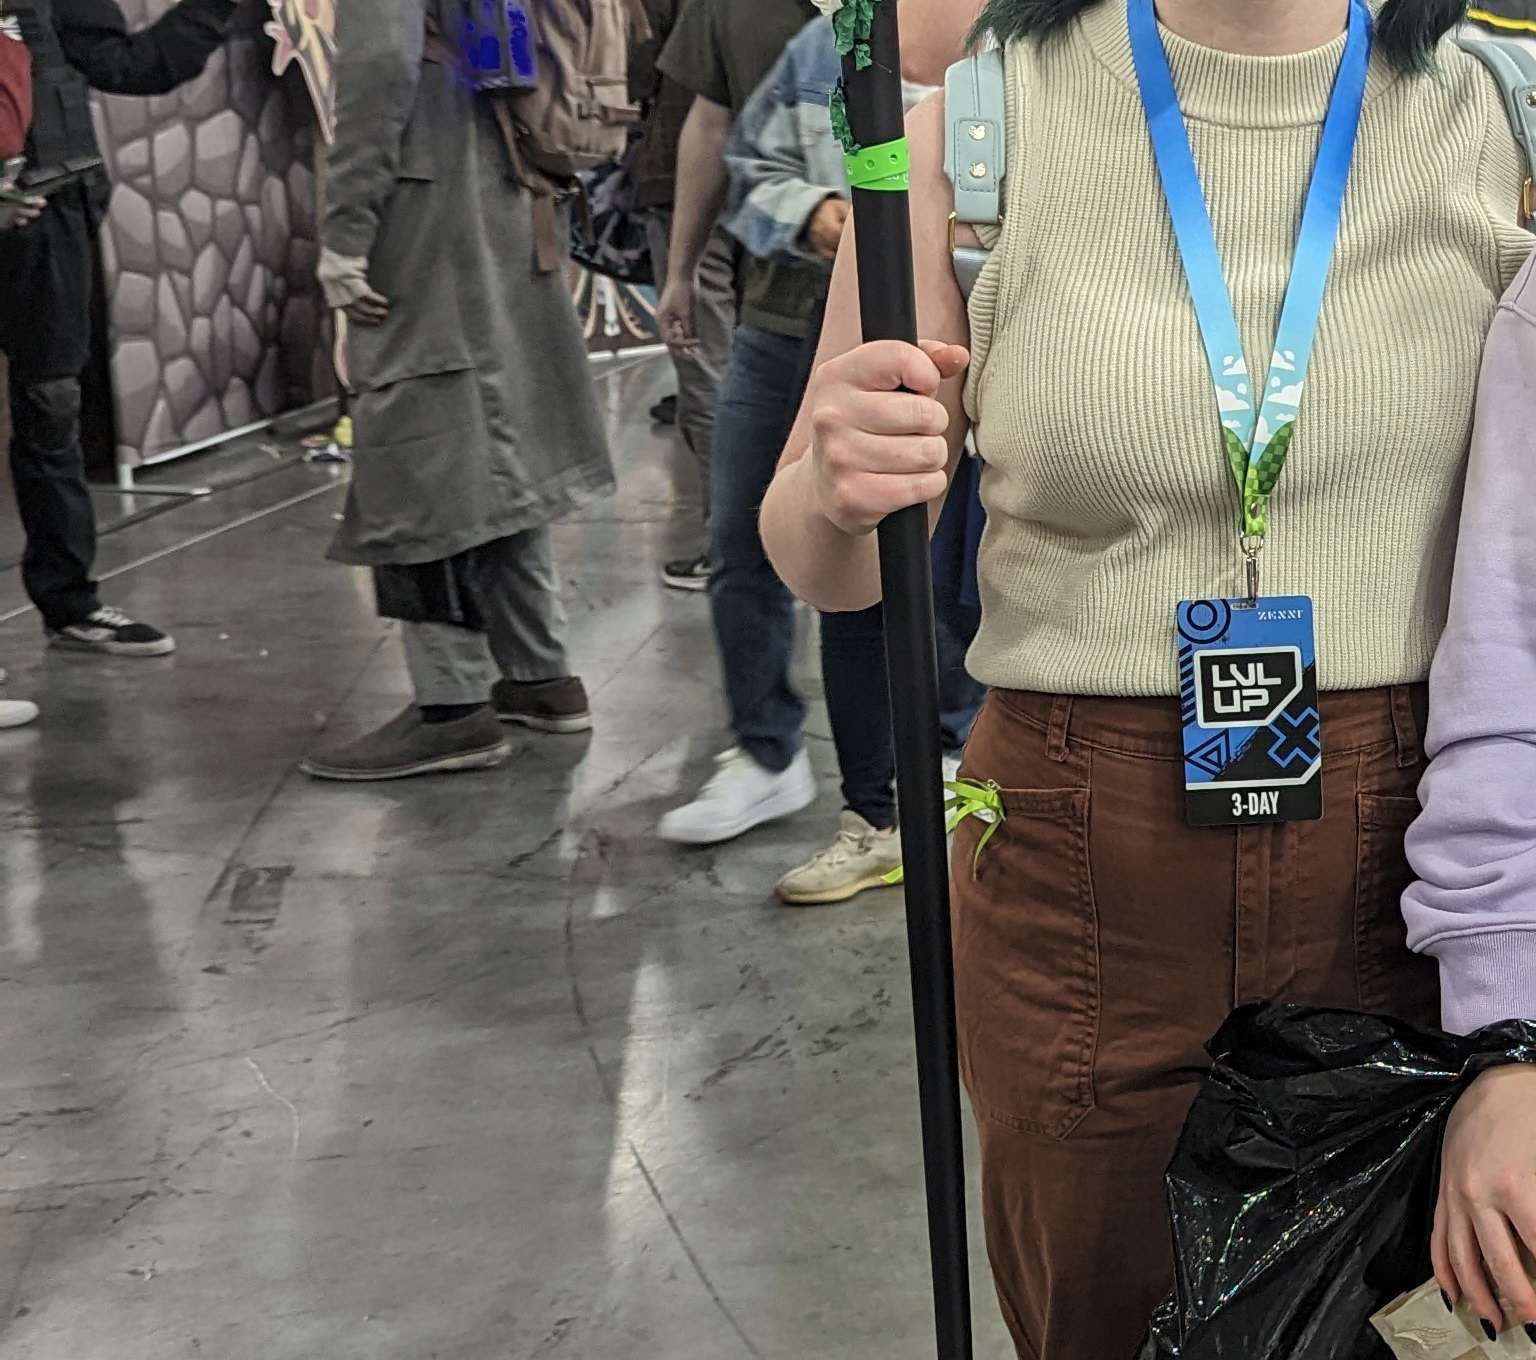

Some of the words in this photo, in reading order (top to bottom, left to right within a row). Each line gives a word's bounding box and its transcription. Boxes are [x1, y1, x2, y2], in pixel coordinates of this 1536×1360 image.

[1211, 662, 1282, 688] LVL
[1213, 688, 1270, 714] UP
[1231, 790, 1280, 817] 3-DAY
